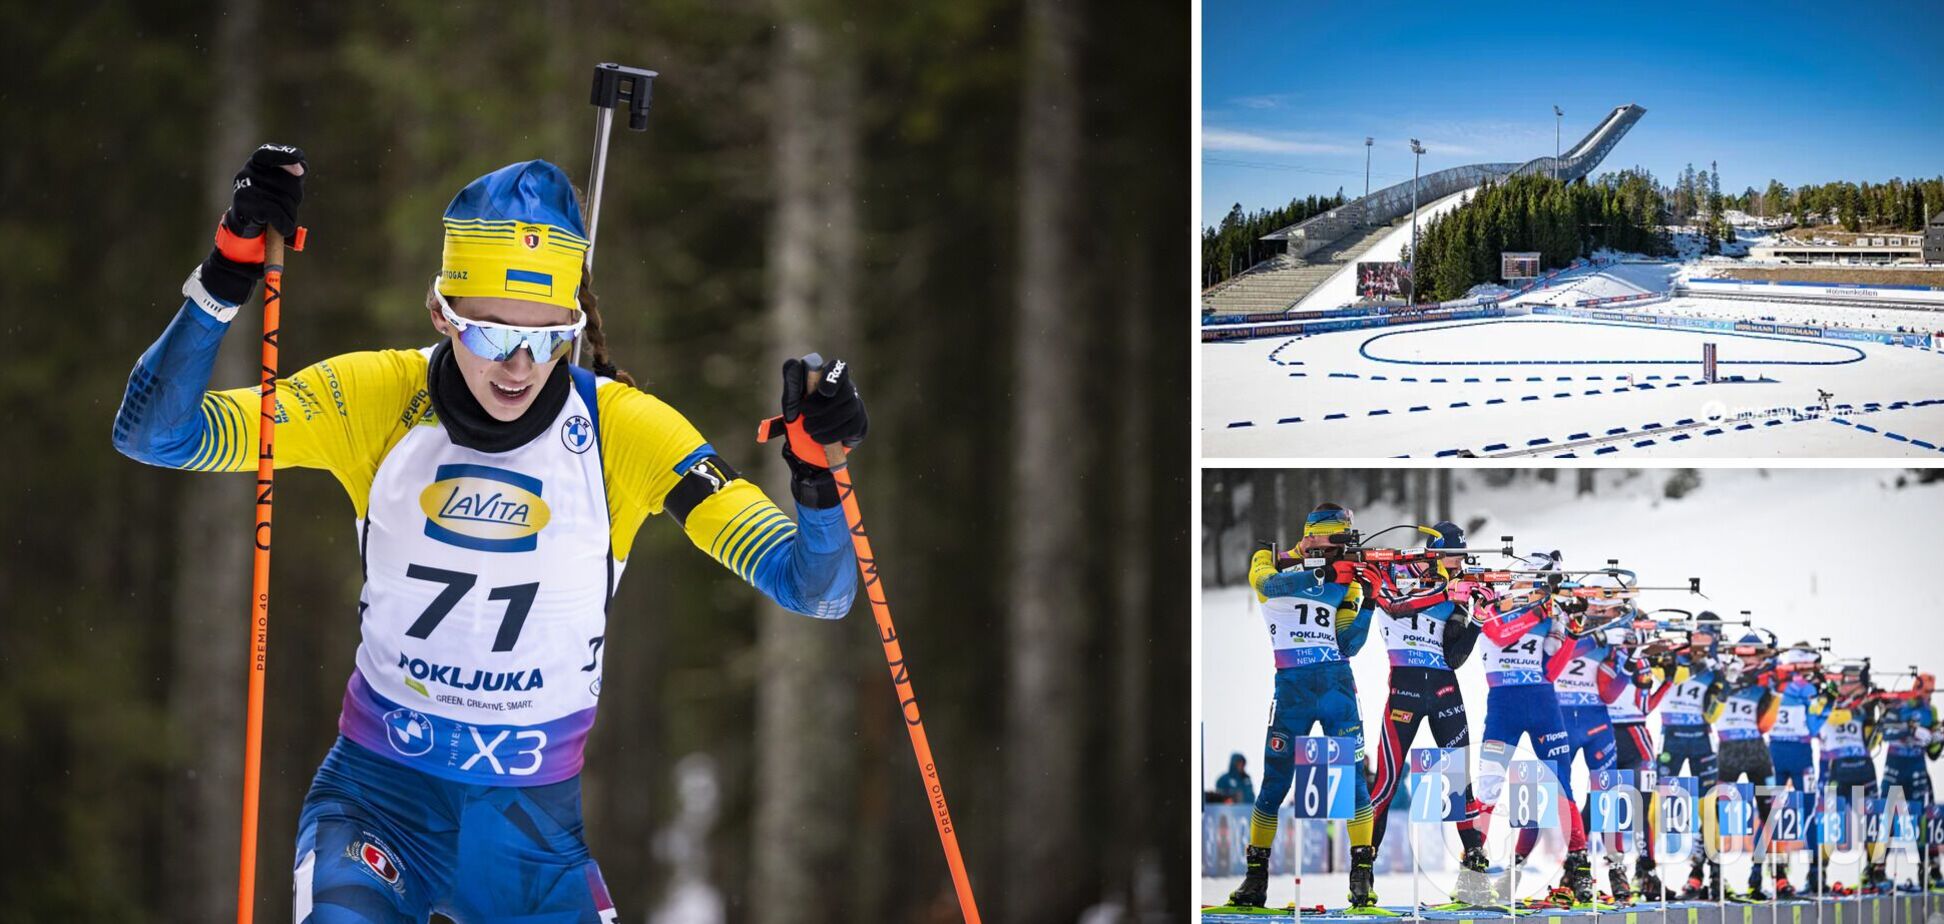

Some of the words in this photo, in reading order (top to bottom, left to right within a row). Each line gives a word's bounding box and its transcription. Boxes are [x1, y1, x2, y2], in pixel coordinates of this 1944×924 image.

[259, 593, 268, 610] 40
[404, 562, 541, 653] 71
[1294, 603, 1331, 628] 18
[256, 617, 268, 671] PREMIO
[1296, 657, 1317, 665] NEW
[1318, 647, 1342, 663] X3
[398, 651, 544, 692] POKLJUKA
[1520, 670, 1543, 683] X3
[1568, 659, 1586, 676] 2
[460, 726, 548, 776] X3
[925, 763, 936, 779] 40
[932, 785, 952, 834] PREMIO
[1304, 766, 1319, 817] 6
[1420, 774, 1434, 820] 7
[1517, 784, 1530, 827] 8
[1598, 793, 1611, 830] 9
[1662, 796, 1688, 833] 10
[1774, 808, 1796, 840] 12
